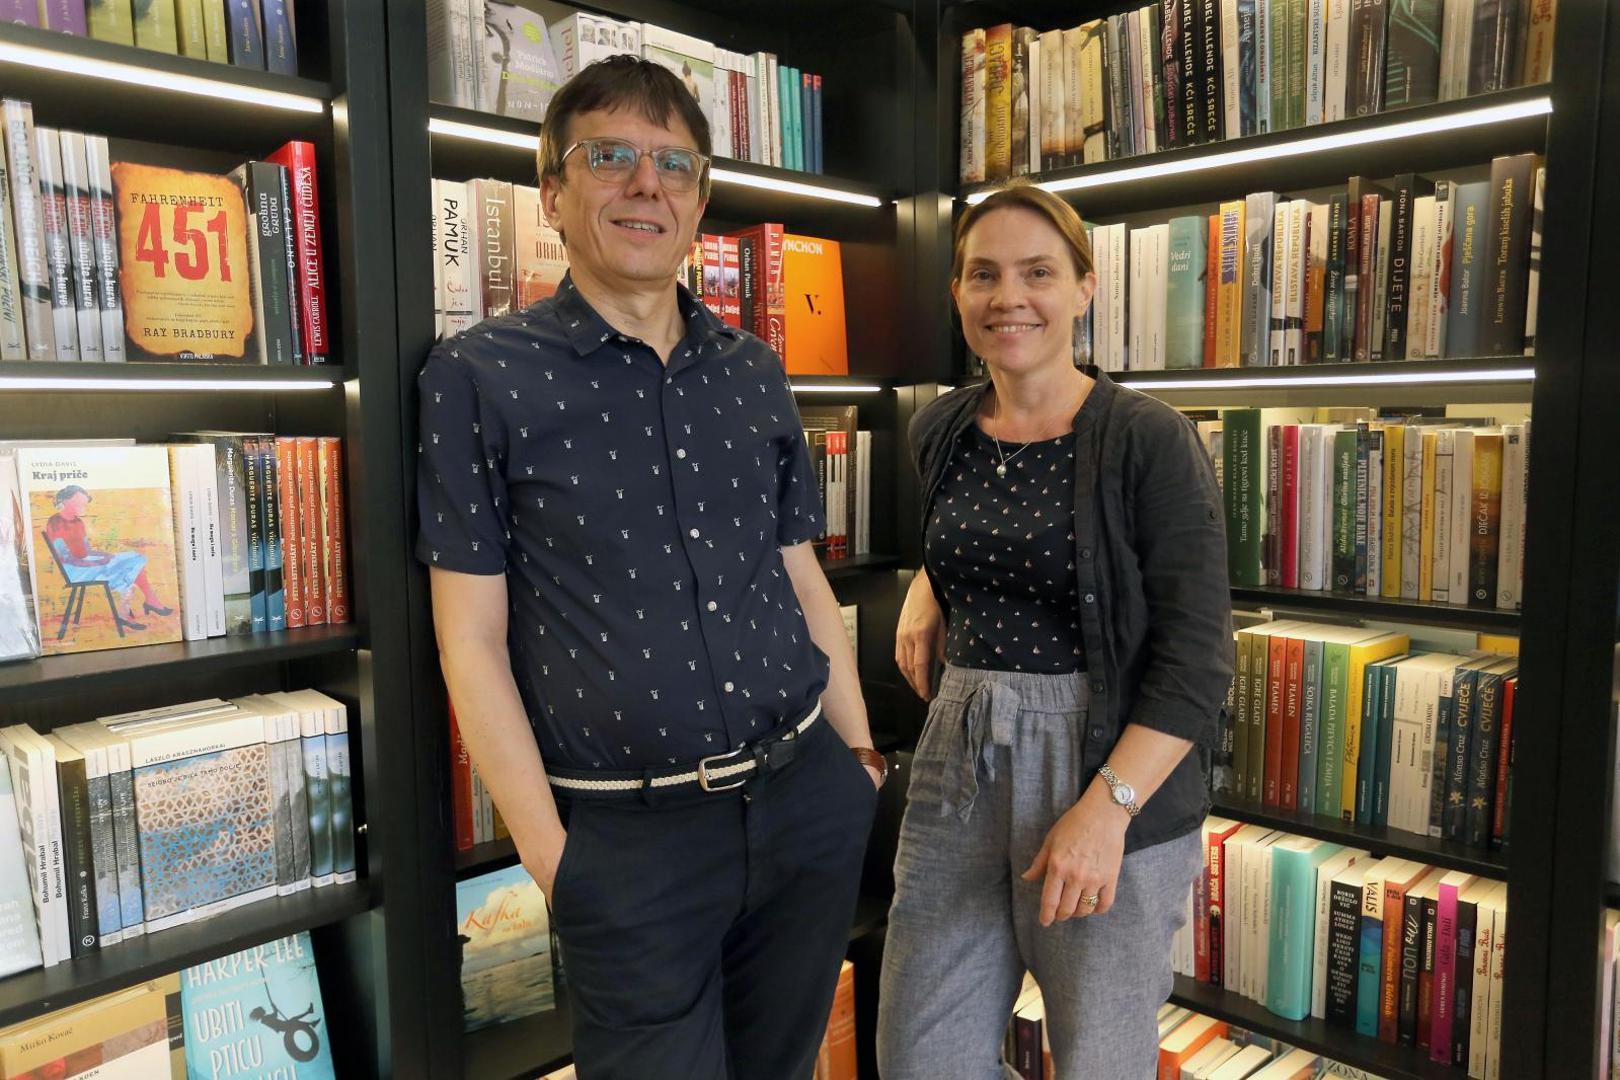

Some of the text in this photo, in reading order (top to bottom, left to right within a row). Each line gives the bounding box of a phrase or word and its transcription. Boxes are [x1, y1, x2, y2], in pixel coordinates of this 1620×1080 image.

[1163, 0, 1171, 23] SABEL
[1184, 32, 1193, 77] ALLENDE
[1204, 26, 1214, 71] ALLENDE
[131, 192, 224, 207] FAHRENHEIT
[300, 167, 312, 207] ČUDESA
[303, 210, 316, 247] ZEMLJI
[1465, 205, 1475, 225] gora
[1498, 178, 1513, 265] Toranj kiselih jabuka
[135, 202, 232, 282] 451
[285, 208, 296, 268] CALVINO
[444, 198, 469, 267] ORHAN PAMUK
[486, 198, 509, 290] Istanbul
[1397, 218, 1405, 251] BARTON
[1462, 226, 1474, 265] Pješčana
[743, 248, 751, 271] Orhan
[769, 233, 780, 275] PAMUK
[1171, 251, 1191, 261] Vedri
[1171, 263, 1189, 272] dani
[1274, 211, 1284, 304] BLISTAVA REPUBLIKA
[1289, 208, 1300, 303] BLISTAVA REPUBLIKA
[78, 240, 94, 308] ubojite kurve
[307, 258, 320, 289] ALICE
[1391, 258, 1406, 312] DIJETE
[57, 276, 69, 306] kurve
[106, 278, 117, 309] kurve
[1459, 289, 1469, 315] Joanna
[311, 296, 321, 325] CARROLL
[144, 328, 236, 340] RAY BRADBURY
[314, 325, 322, 346] LEWIS
[32, 470, 88, 481] Kraj priče
[226, 447, 234, 485] Marguerite
[248, 455, 256, 501] MARGUERITE
[264, 454, 272, 501] MARGUERITE
[250, 504, 258, 529] DURAS
[1241, 504, 1249, 521] gdje
[1356, 459, 1367, 545] PLETENICA MOJE BAKE
[1478, 503, 1488, 535] DJEČAK
[289, 543, 298, 580] ESTERHÁZY
[310, 541, 319, 578] ESTERHÁZY
[334, 541, 343, 578] ESTERHÁZY
[1239, 675, 1247, 695] IGRE
[1253, 678, 1262, 726] IGRE GLADI
[1271, 681, 1280, 715] PLAMEN
[1287, 682, 1297, 717] PLAMEN
[1238, 696, 1246, 723] GLADI
[1304, 684, 1315, 755] ŠOJKA RUGALICA
[1328, 688, 1338, 721] BALADA
[1327, 722, 1336, 755] PJEVICA
[1456, 734, 1466, 754] Cruz
[1479, 739, 1489, 759] Cruz
[1324, 760, 1333, 787] ZMIJA
[1454, 756, 1465, 784] Afonso
[1477, 761, 1489, 789] Afonso
[38, 844, 50, 904] Bohumil Hrabal
[52, 840, 62, 899] Bohumil Hrabal
[81, 884, 89, 903] Kafka
[1337, 890, 1355, 899] BORIS
[1366, 882, 1379, 914] VALIS
[464, 893, 522, 938] Kafka
[188, 934, 304, 988] HARPER LEE
[1403, 946, 1418, 980] non
[194, 1000, 245, 1043] UBITI
[20, 1027, 74, 1053] Mirko Kovač
[210, 1034, 264, 1080] PTICU
